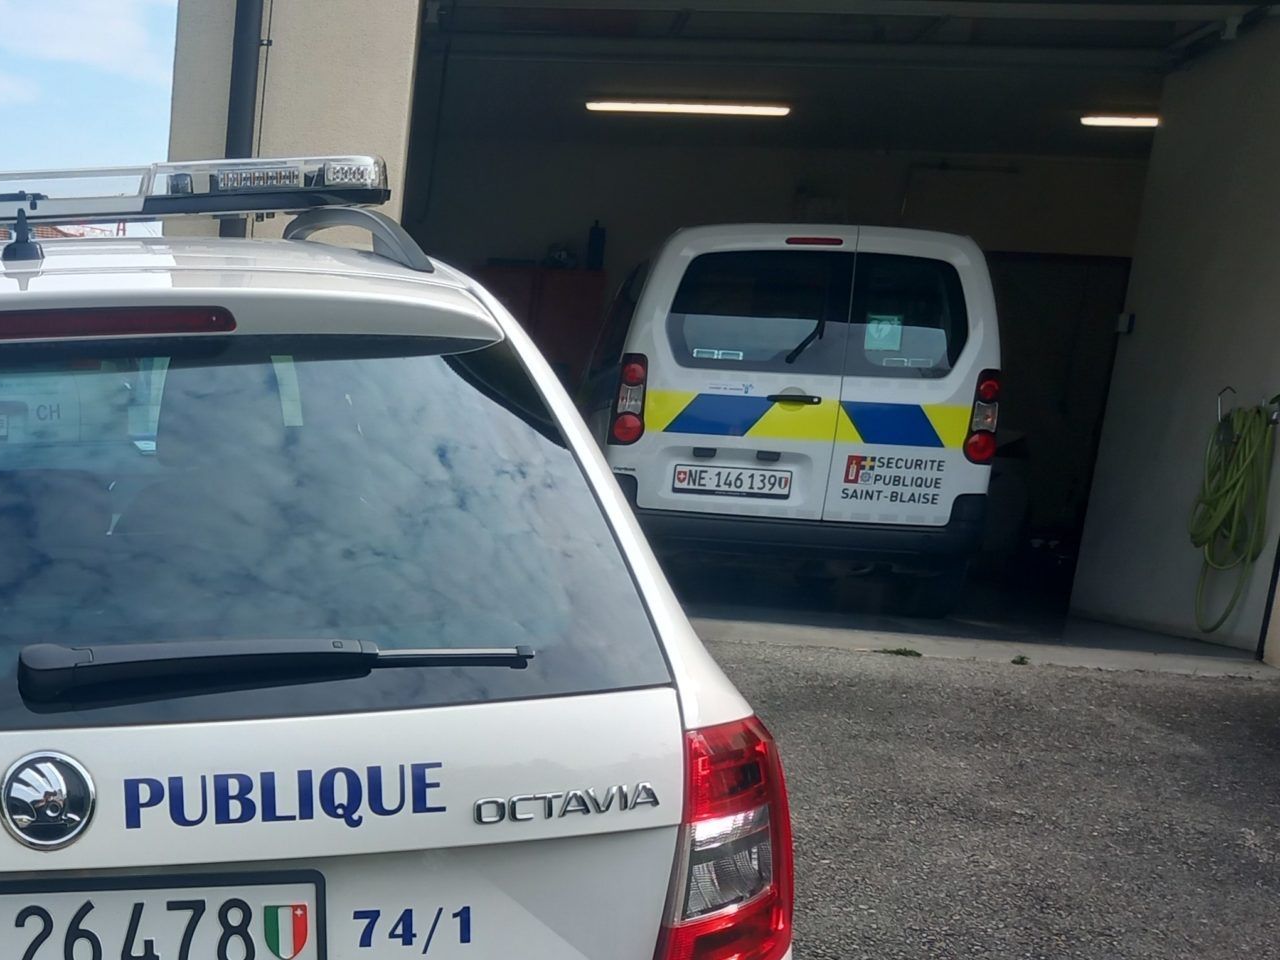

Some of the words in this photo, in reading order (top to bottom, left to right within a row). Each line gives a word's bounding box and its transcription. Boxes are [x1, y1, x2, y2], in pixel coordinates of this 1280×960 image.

[35, 404, 62, 421] CH
[876, 456, 946, 472] SECURITE
[873, 473, 943, 489] PUBLIQUE
[840, 487, 940, 505] SAINT-BLAISE
[123, 762, 447, 829] PUBLIQUE
[472, 781, 661, 826] OCTAVIA
[352, 905, 474, 955] 74/1
